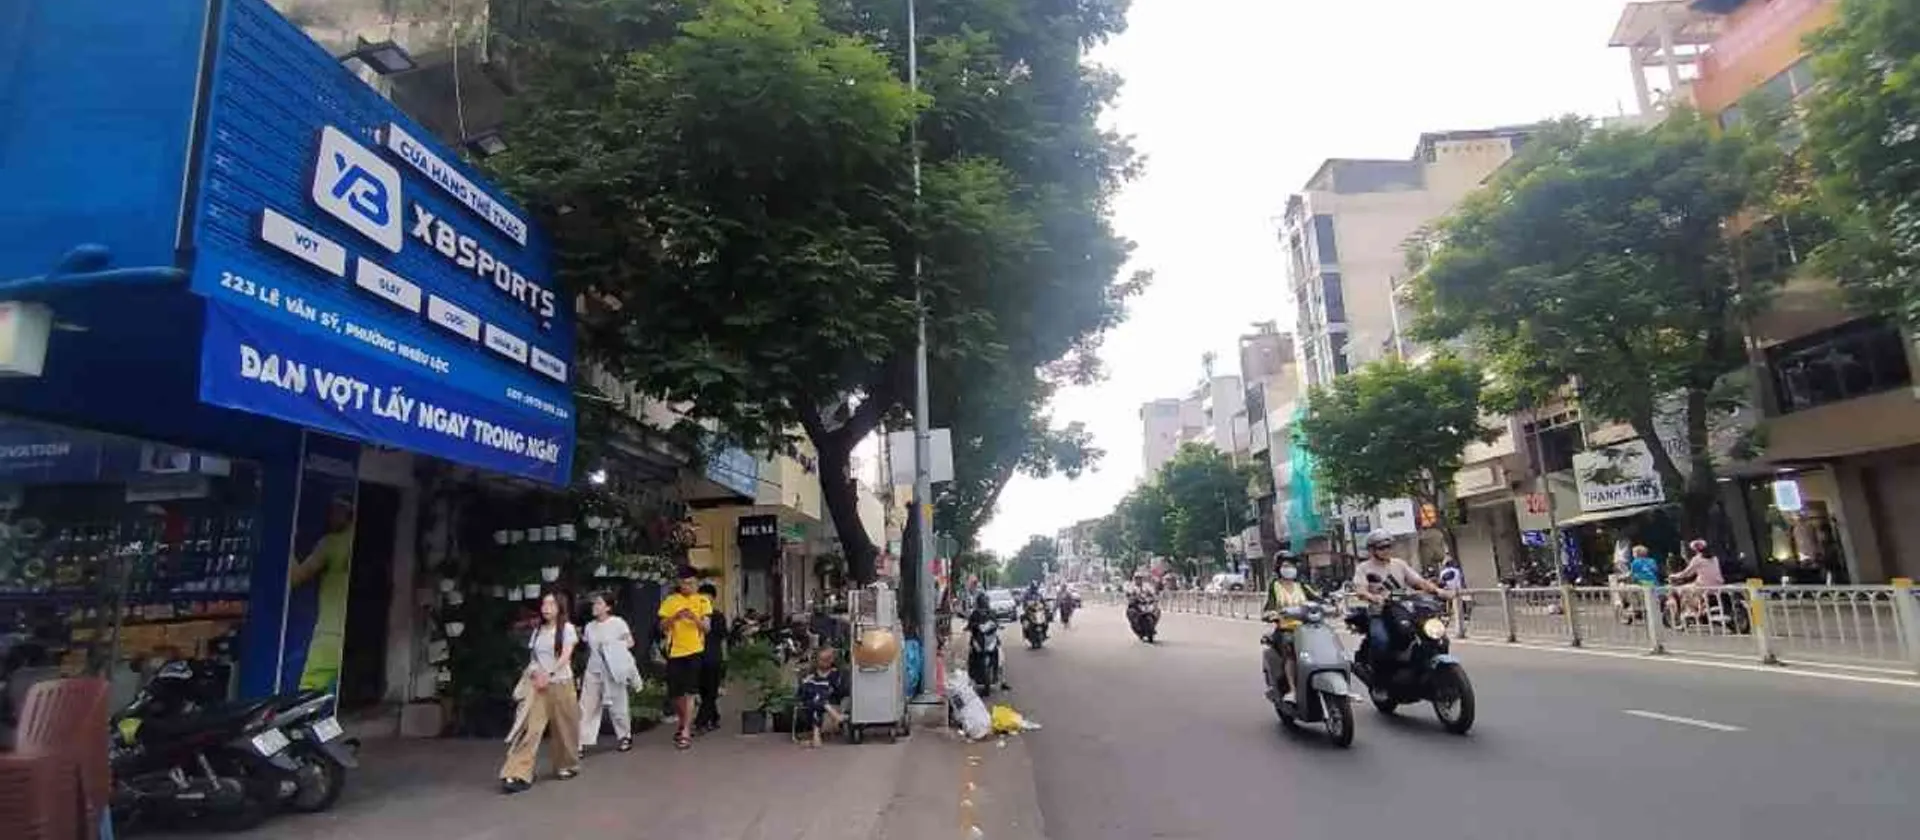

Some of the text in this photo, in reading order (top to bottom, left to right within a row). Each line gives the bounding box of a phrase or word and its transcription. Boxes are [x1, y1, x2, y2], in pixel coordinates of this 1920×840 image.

[220, 271, 256, 297] 223
[411, 203, 556, 318] XBSPORTS
[313, 367, 370, 412] VỢT
[418, 401, 471, 440] NGAY
[472, 417, 526, 454] TRONG
